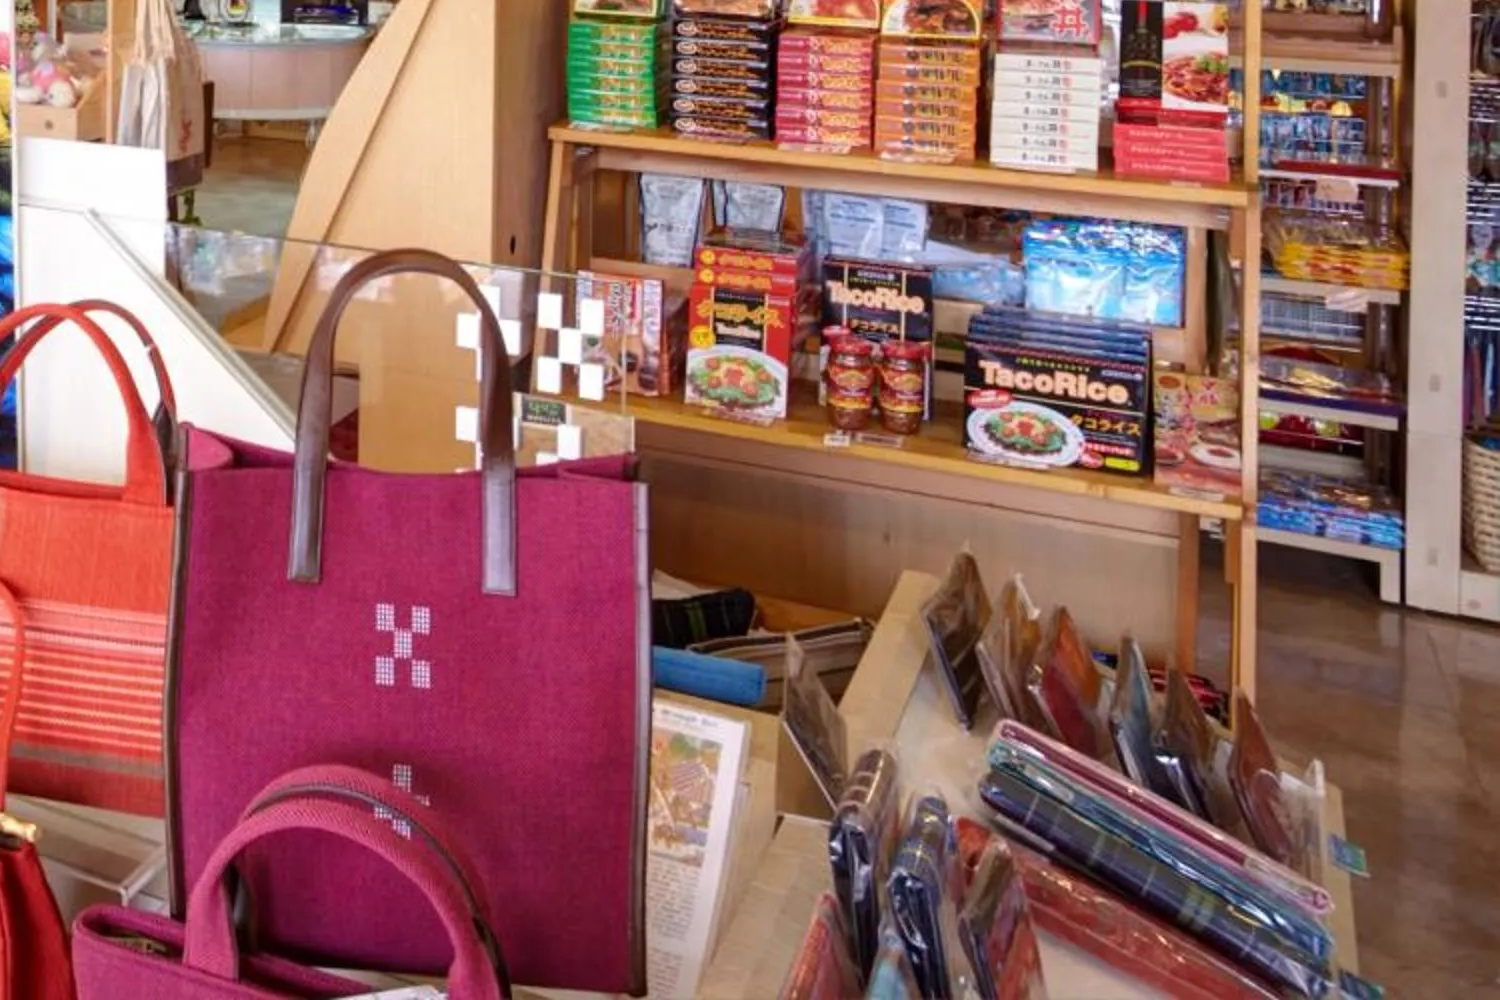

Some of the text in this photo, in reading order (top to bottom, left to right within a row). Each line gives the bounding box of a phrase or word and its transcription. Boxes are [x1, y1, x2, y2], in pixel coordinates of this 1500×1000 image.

[826, 280, 925, 314] TacoRice
[979, 360, 1130, 405] TacoRice
[1071, 414, 1141, 436] タコライス
